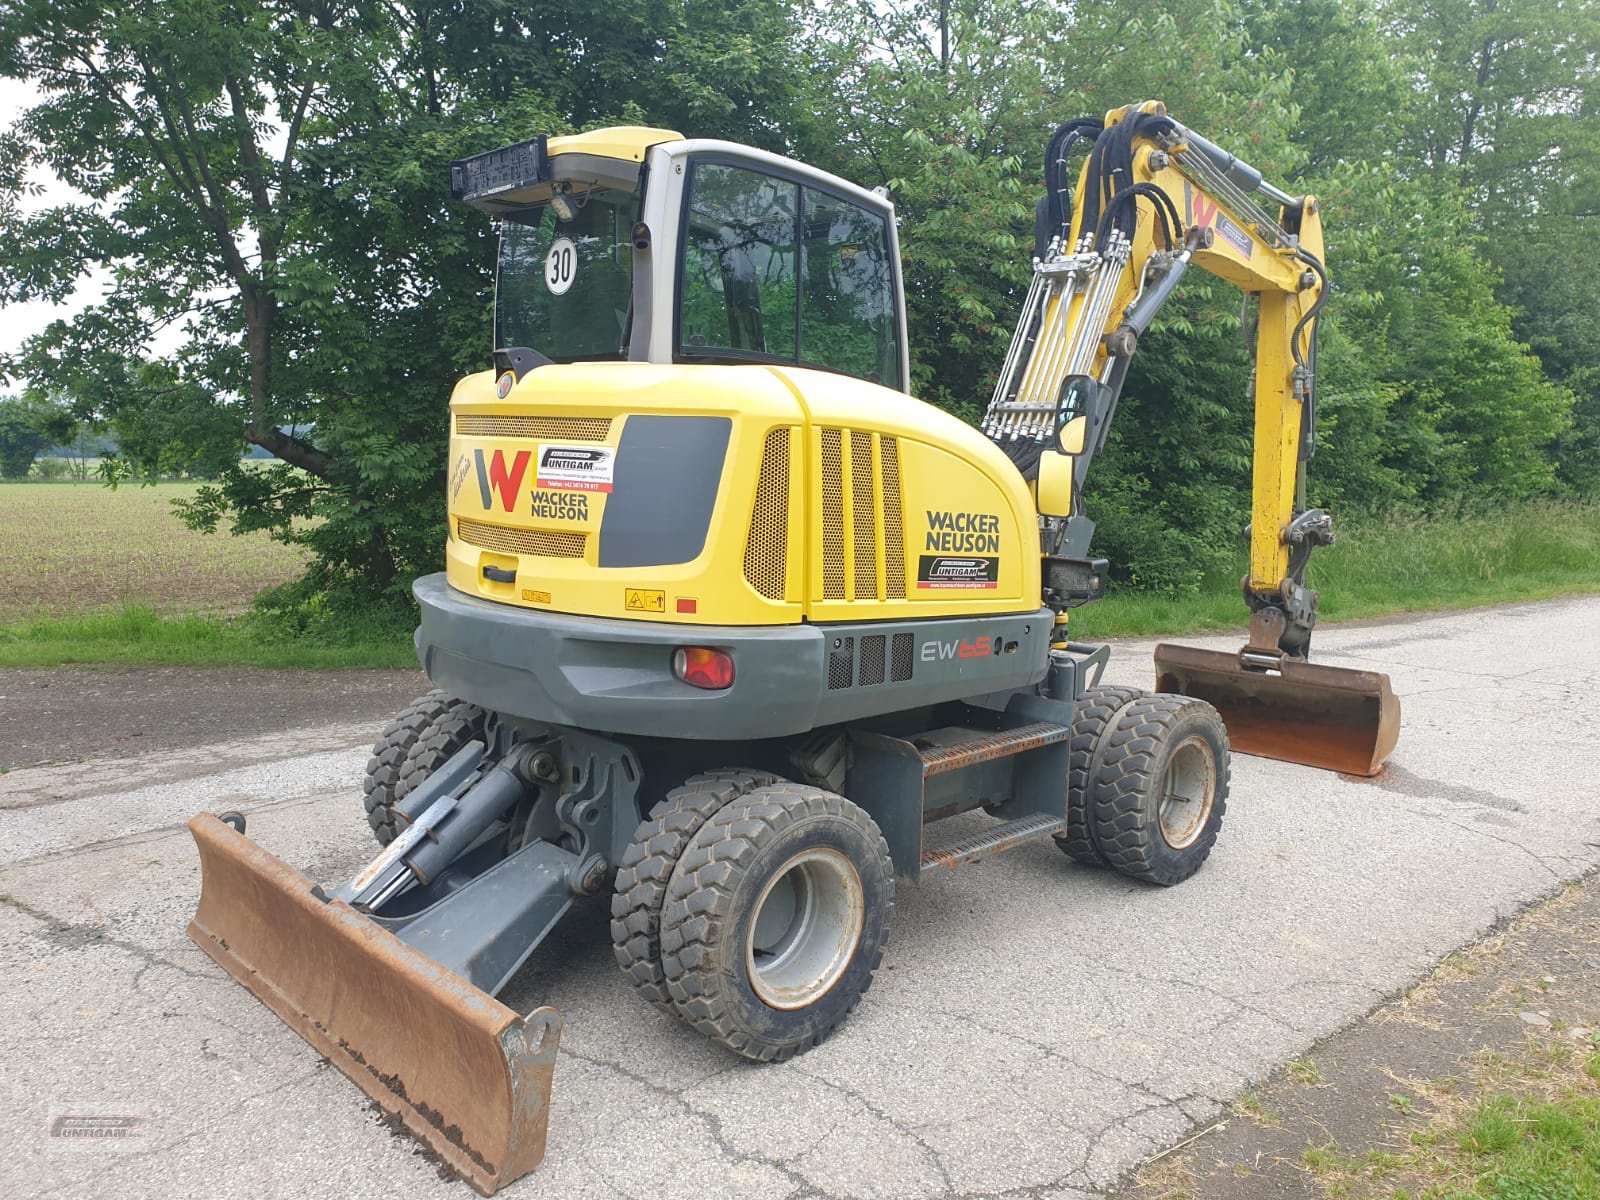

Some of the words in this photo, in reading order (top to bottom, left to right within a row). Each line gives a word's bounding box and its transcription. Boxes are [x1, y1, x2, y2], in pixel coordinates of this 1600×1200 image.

[551, 247, 571, 285] 30
[531, 490, 588, 508] WACKER
[531, 506, 588, 521] NEUSON
[926, 510, 1000, 534] WACKER
[926, 532, 1000, 553] NEUSON
[920, 636, 992, 662] EW65
